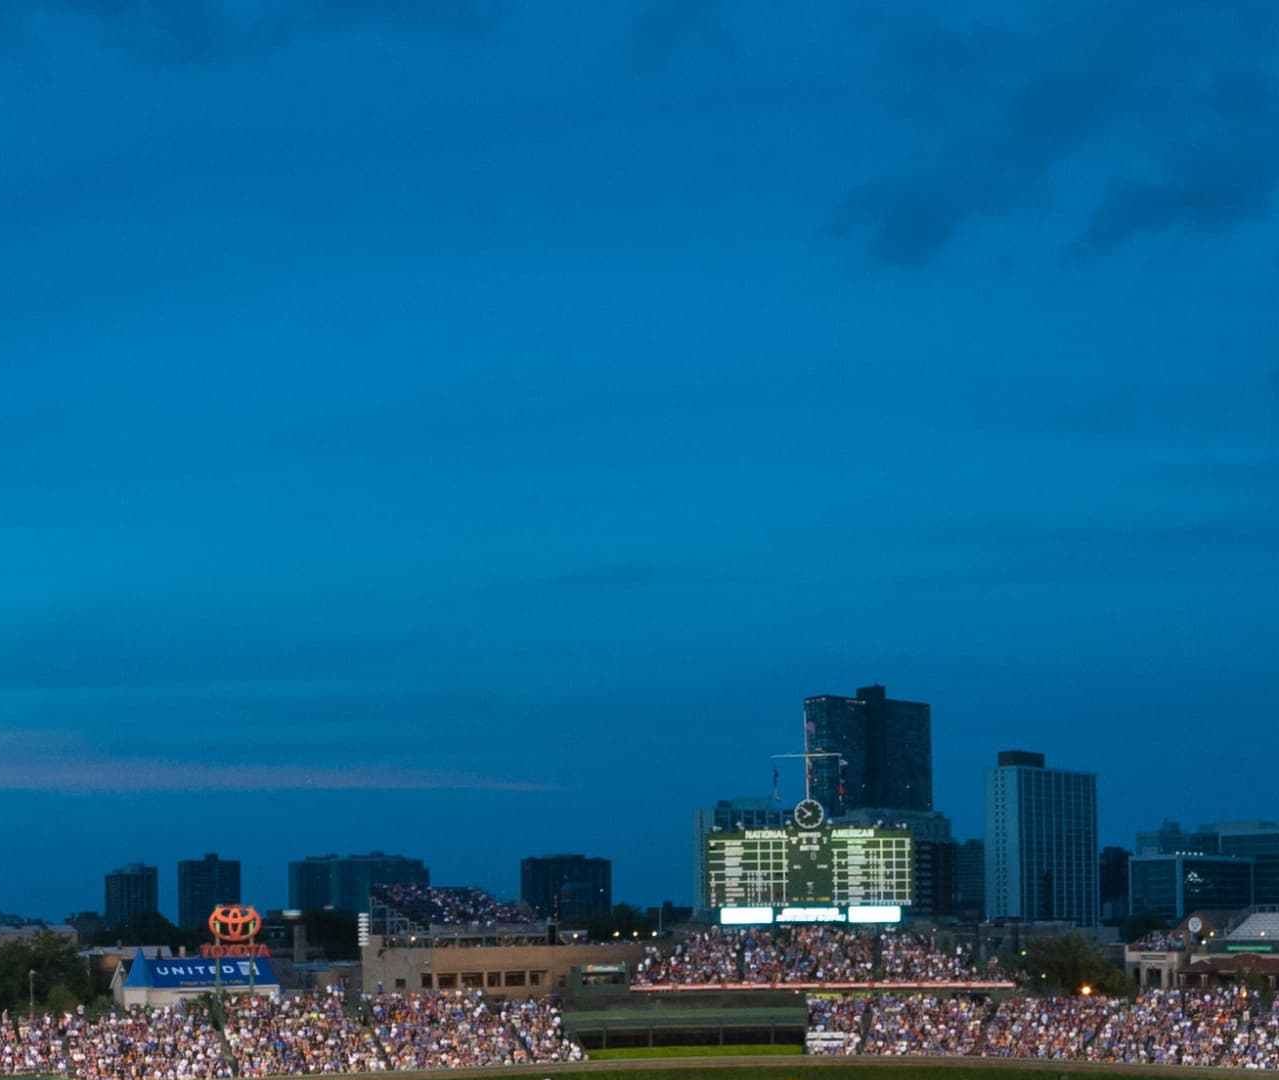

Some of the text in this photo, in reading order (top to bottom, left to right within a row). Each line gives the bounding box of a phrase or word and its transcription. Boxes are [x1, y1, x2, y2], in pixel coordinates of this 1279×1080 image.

[745, 830, 788, 839] NATIONAL
[831, 829, 875, 838] AMERICAN
[200, 944, 271, 957] TOYOTA
[156, 965, 235, 976] UNITED
